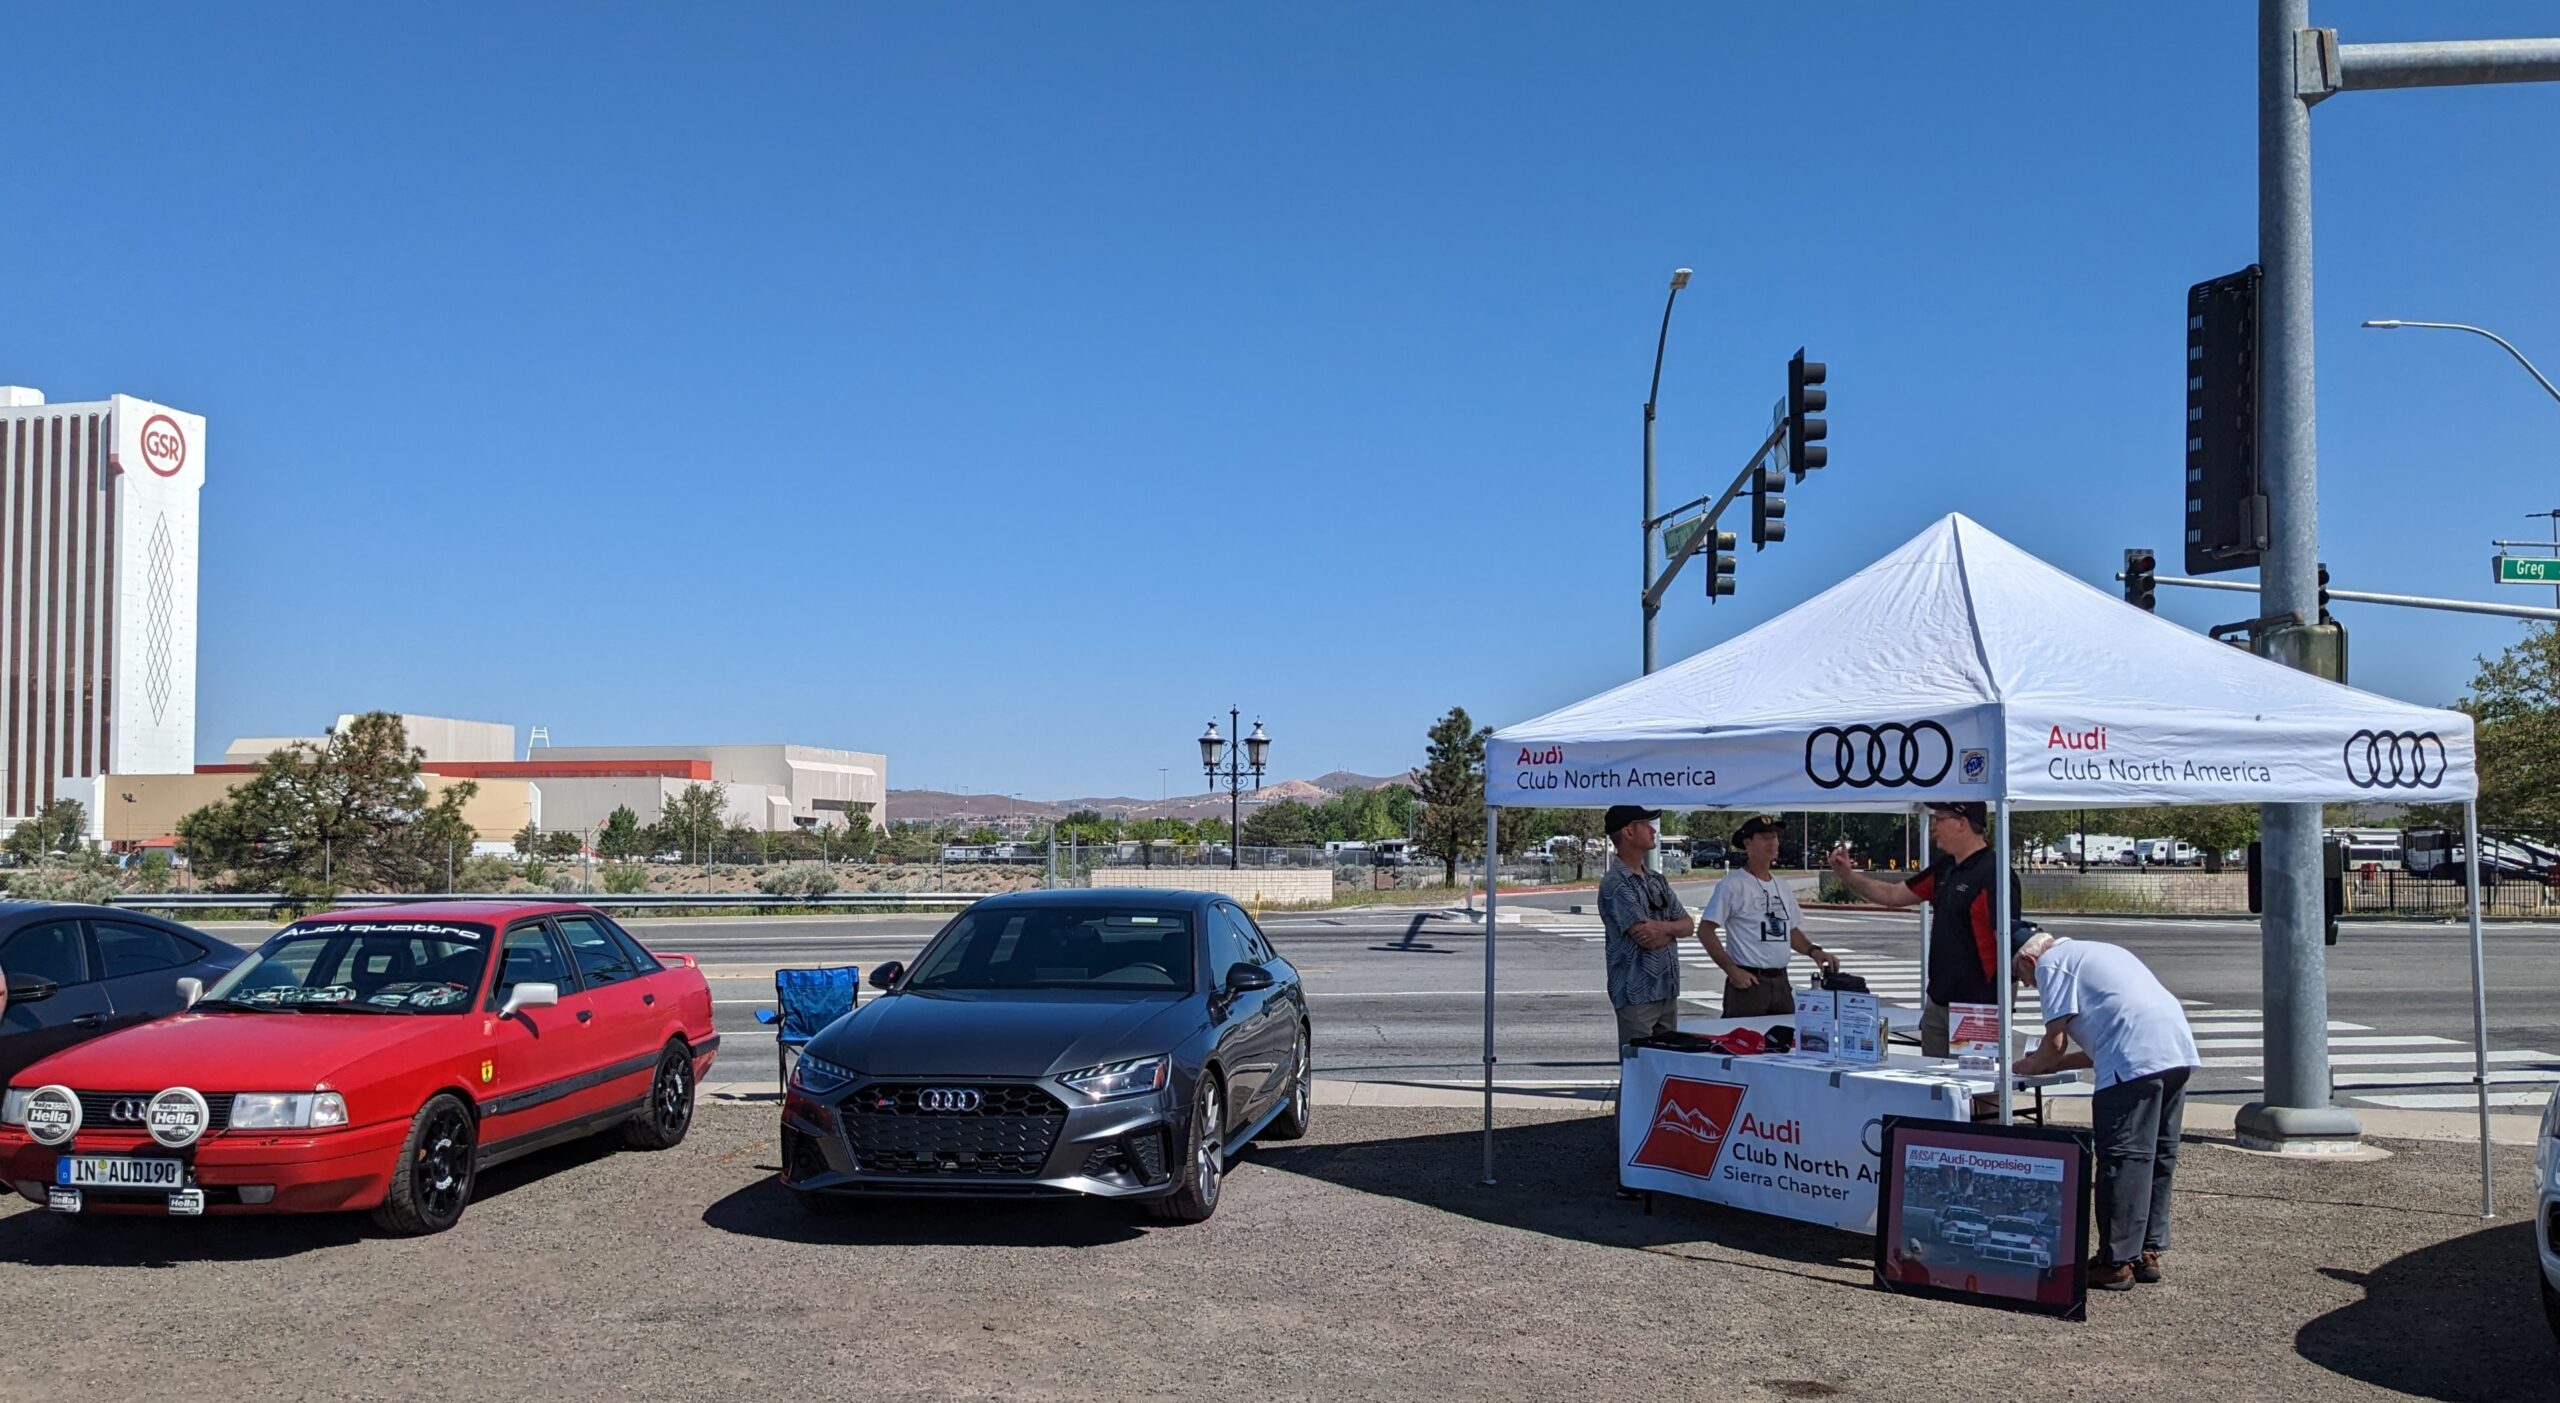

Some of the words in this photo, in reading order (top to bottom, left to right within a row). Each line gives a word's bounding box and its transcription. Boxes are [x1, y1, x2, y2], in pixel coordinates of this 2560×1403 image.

[146, 431, 179, 462] GSR
[2516, 560, 2545, 580] Greg
[2048, 725, 2107, 750] Audi
[1516, 746, 1563, 766] Audi
[1516, 771, 1558, 790] Club
[1564, 768, 1621, 789] North
[1627, 766, 1716, 788] America
[2048, 757, 2102, 781] Club
[2109, 758, 2177, 781] North
[2183, 760, 2272, 782] America
[276, 924, 348, 940] Audi
[349, 924, 481, 940] quattro
[30, 1109, 68, 1123] Hella
[154, 1111, 196, 1124] Hella
[1738, 1112, 1800, 1145] Audi
[75, 1160, 96, 1182] IN
[109, 1161, 176, 1184] AUDI90
[1732, 1142, 1777, 1167] Club
[1784, 1151, 1849, 1179] North
[1909, 1149, 1935, 1162] IMSA
[1938, 1152, 2032, 1174] Audi-Doppelsieg
[1723, 1165, 1773, 1187] Sierra
[1777, 1175, 1850, 1201] Chapter
[51, 1196, 75, 1205] Hella
[170, 1199, 197, 1207] Hella
